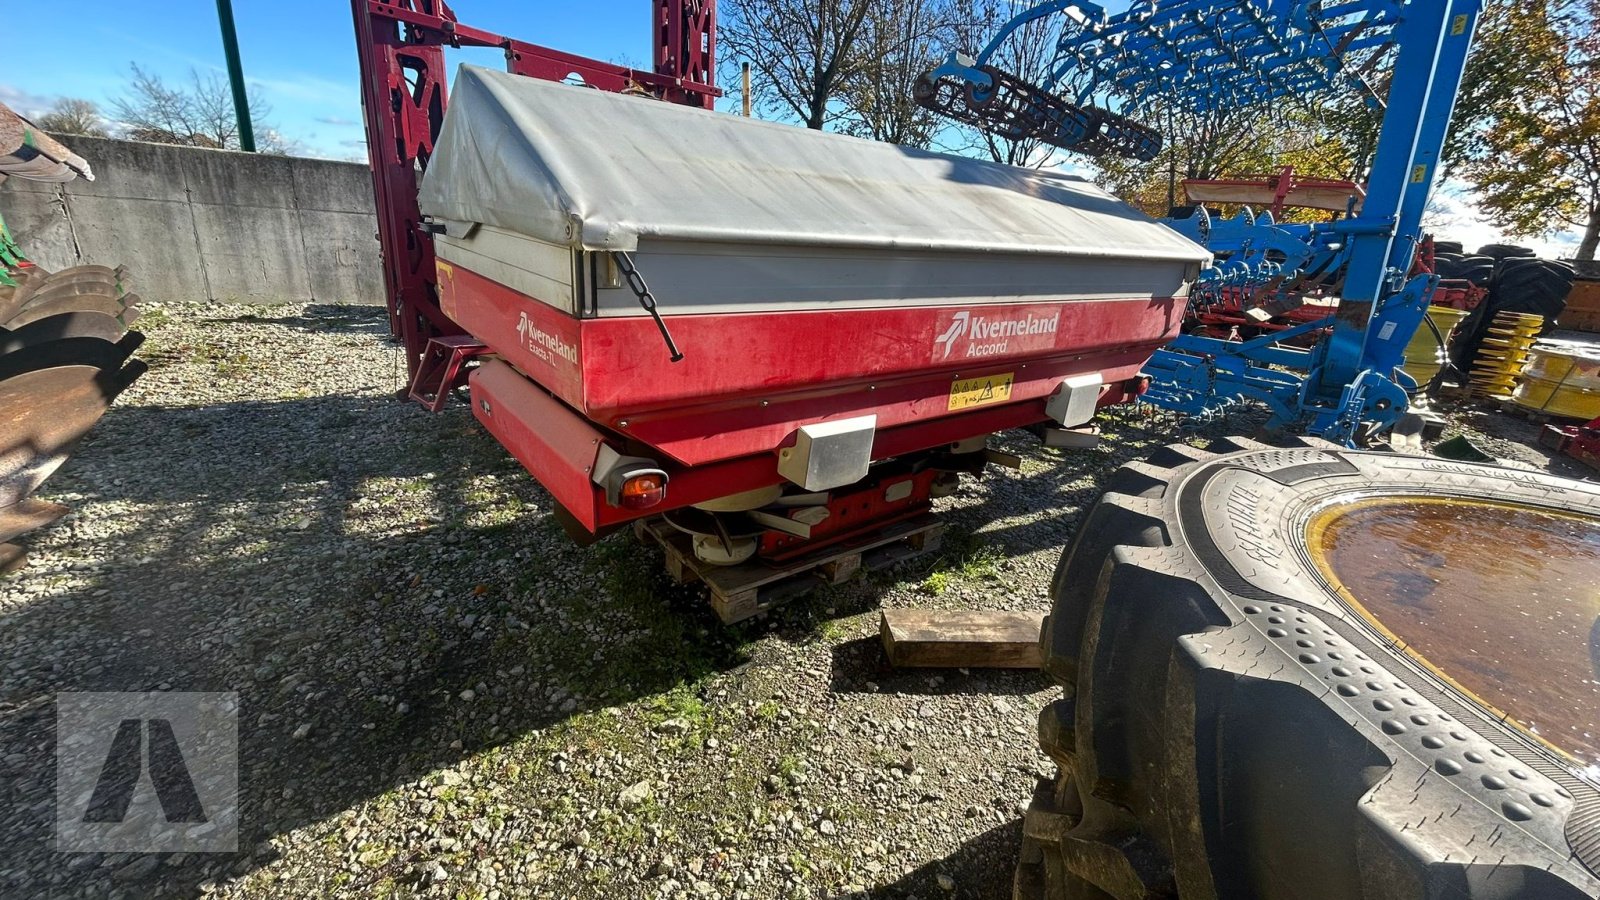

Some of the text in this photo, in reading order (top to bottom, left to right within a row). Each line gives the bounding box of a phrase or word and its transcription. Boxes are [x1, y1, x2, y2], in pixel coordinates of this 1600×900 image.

[969, 312, 1059, 340] Kverneland
[528, 320, 578, 365] Kverneland
[966, 340, 1008, 358] Accord
